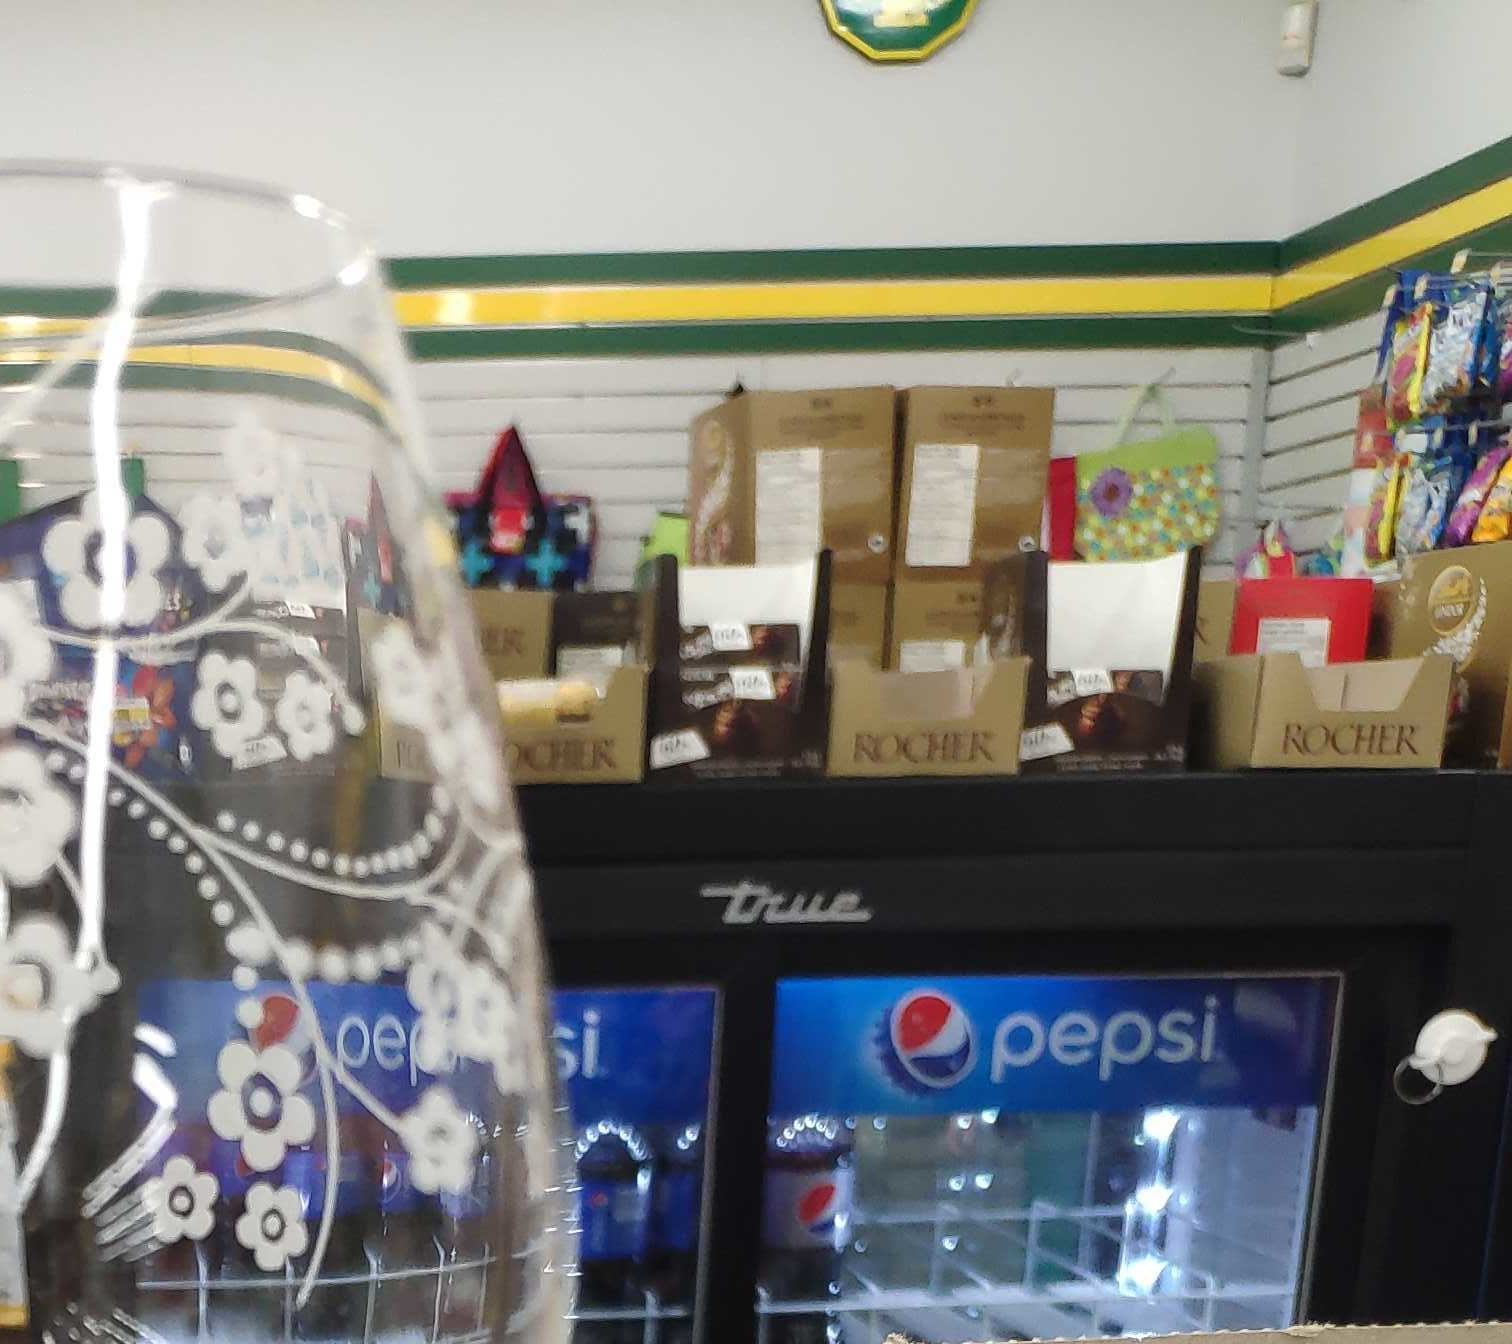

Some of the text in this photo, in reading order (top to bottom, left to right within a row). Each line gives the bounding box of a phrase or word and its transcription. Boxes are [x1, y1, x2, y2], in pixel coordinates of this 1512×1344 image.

[853, 731, 994, 764] ROCHER
[1282, 722, 1418, 756] ROCHER
[990, 994, 1220, 1084] pepsi
